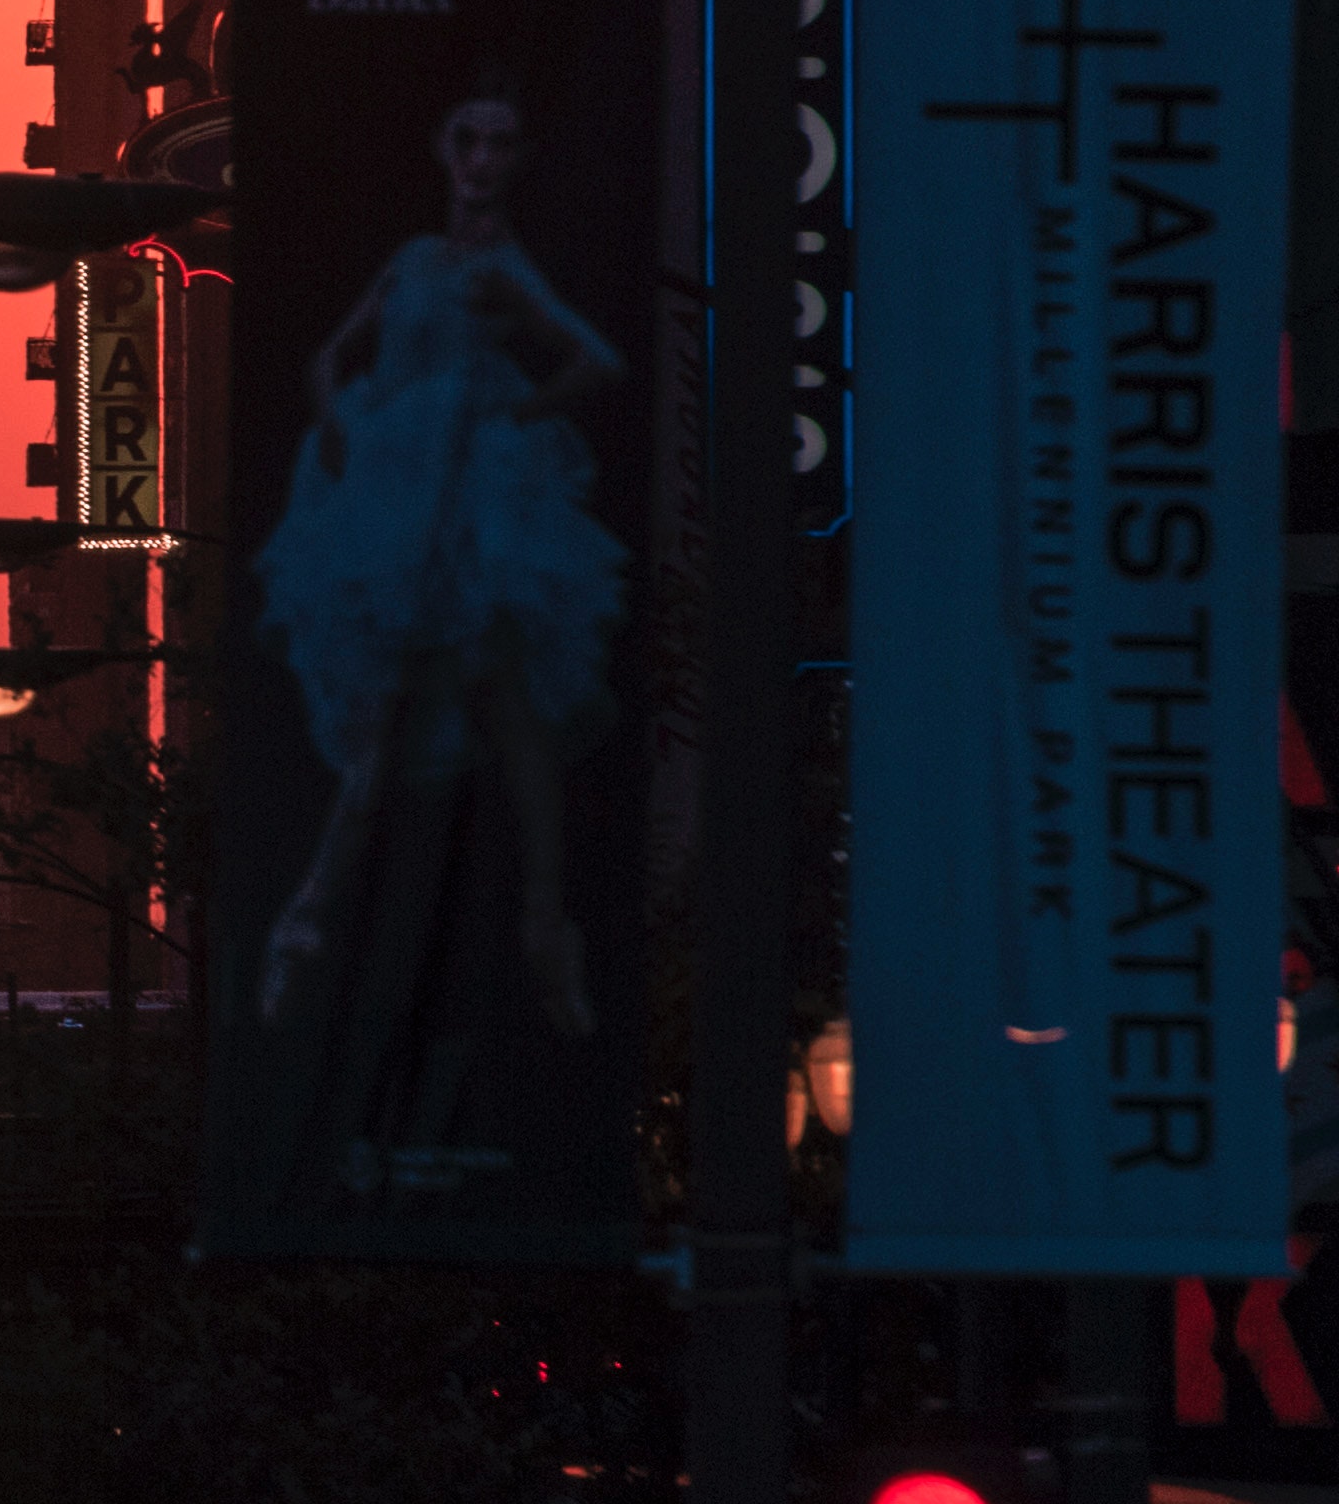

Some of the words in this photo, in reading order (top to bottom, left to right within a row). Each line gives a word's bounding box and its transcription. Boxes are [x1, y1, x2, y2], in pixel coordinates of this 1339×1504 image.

[101, 265, 149, 529] PARK
[1031, 205, 1077, 685] MILLENNIUM
[1029, 727, 1075, 918] PARK
